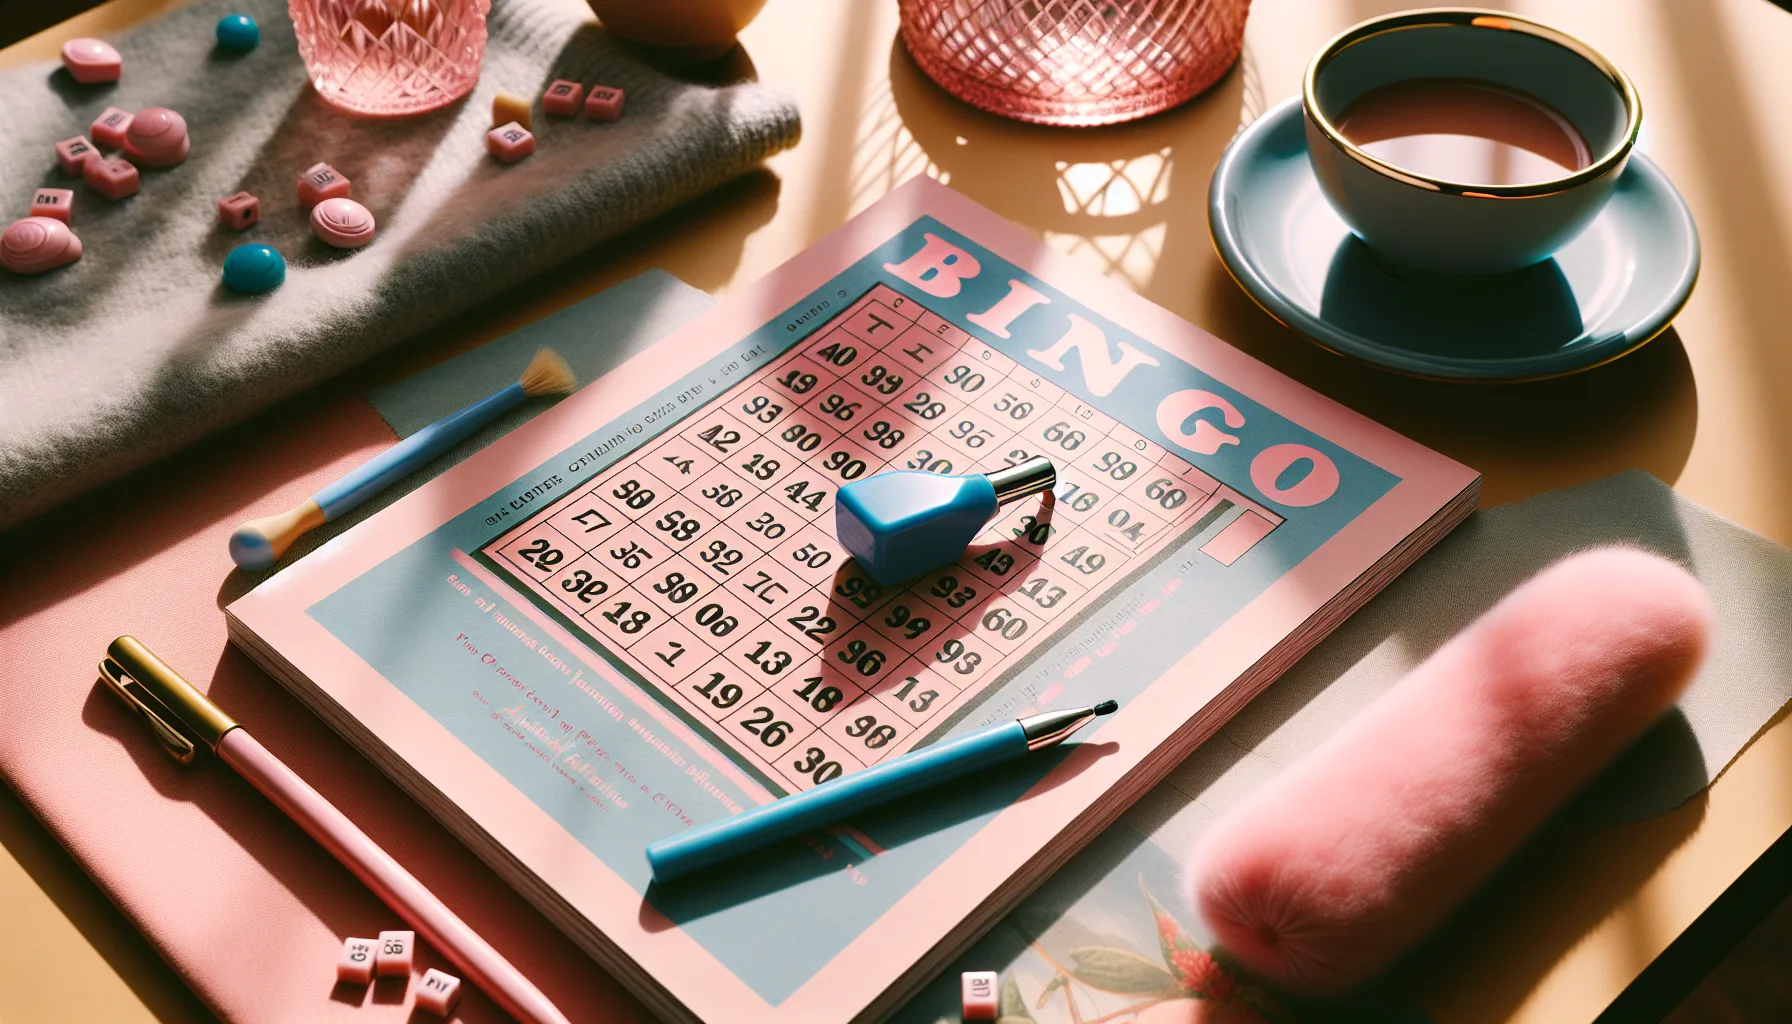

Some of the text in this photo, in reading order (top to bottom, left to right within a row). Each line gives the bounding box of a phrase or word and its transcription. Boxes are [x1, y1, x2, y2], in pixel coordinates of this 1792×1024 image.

[883, 233, 1340, 506] BINGO
[819, 393, 862, 422] 96
[823, 451, 867, 480] 90
[787, 606, 837, 645] 22
[982, 608, 1028, 640] 60
[744, 641, 792, 675] 13
[602, 602, 651, 634] 18
[692, 672, 743, 709] 19
[740, 706, 794, 747] 26
[793, 747, 843, 785] 30
